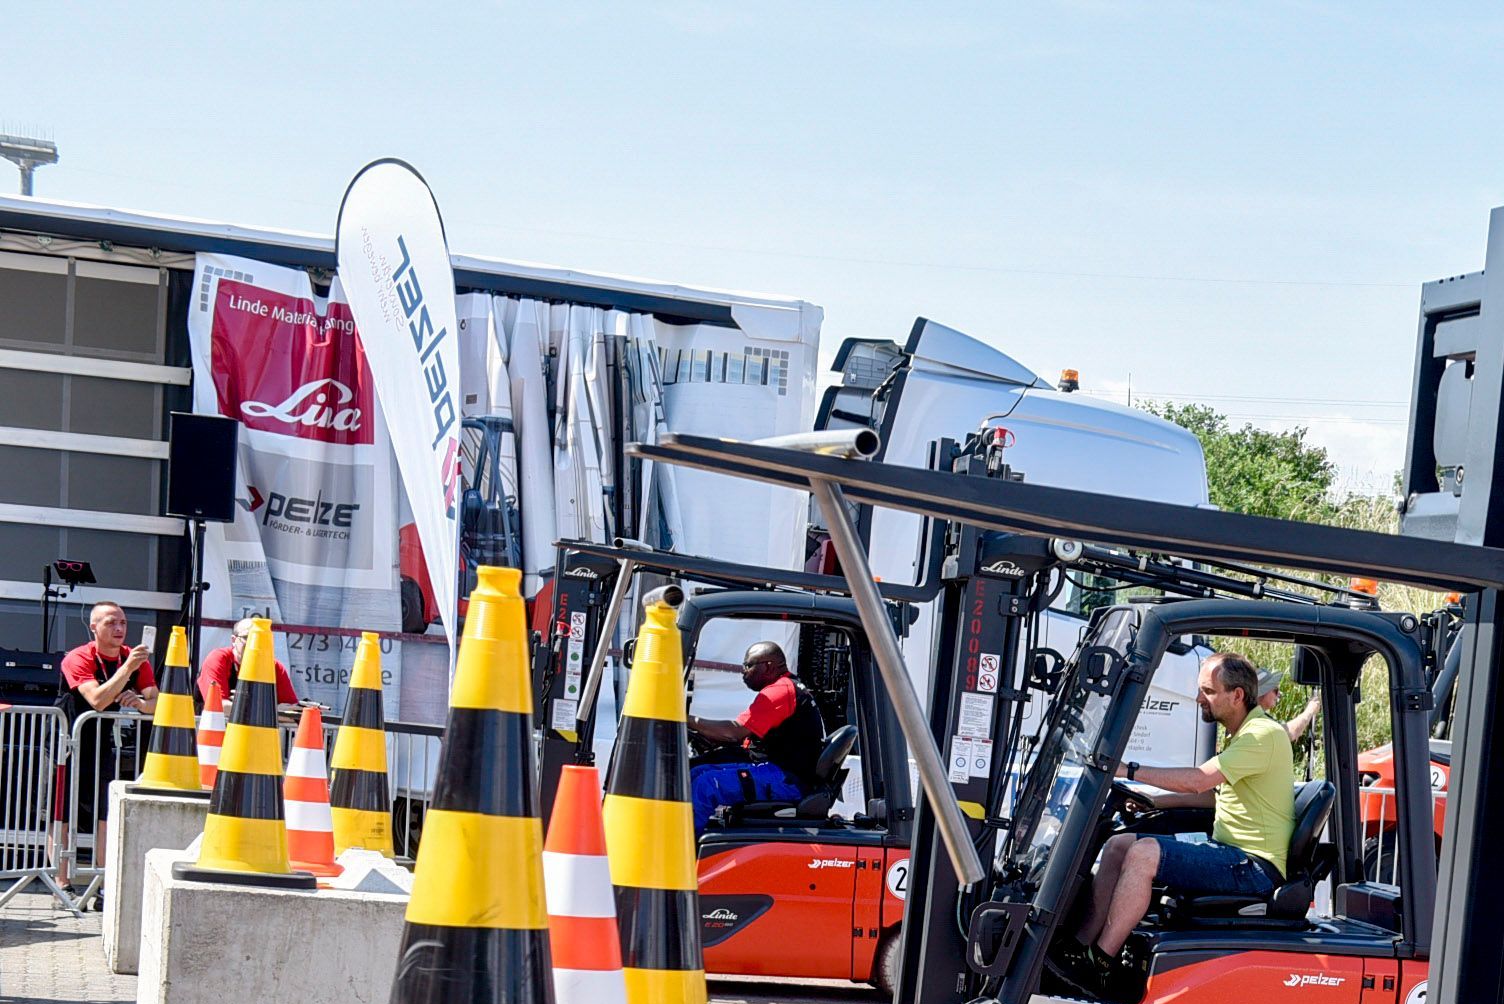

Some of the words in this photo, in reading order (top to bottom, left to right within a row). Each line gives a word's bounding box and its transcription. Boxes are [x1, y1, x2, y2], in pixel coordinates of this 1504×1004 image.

[229, 294, 269, 317] Linde
[565, 566, 599, 579] Linde
[981, 561, 1025, 577] Linde
[820, 857, 855, 868] pelzer
[702, 908, 738, 921] Linde
[1300, 973, 1346, 987] pelzer
